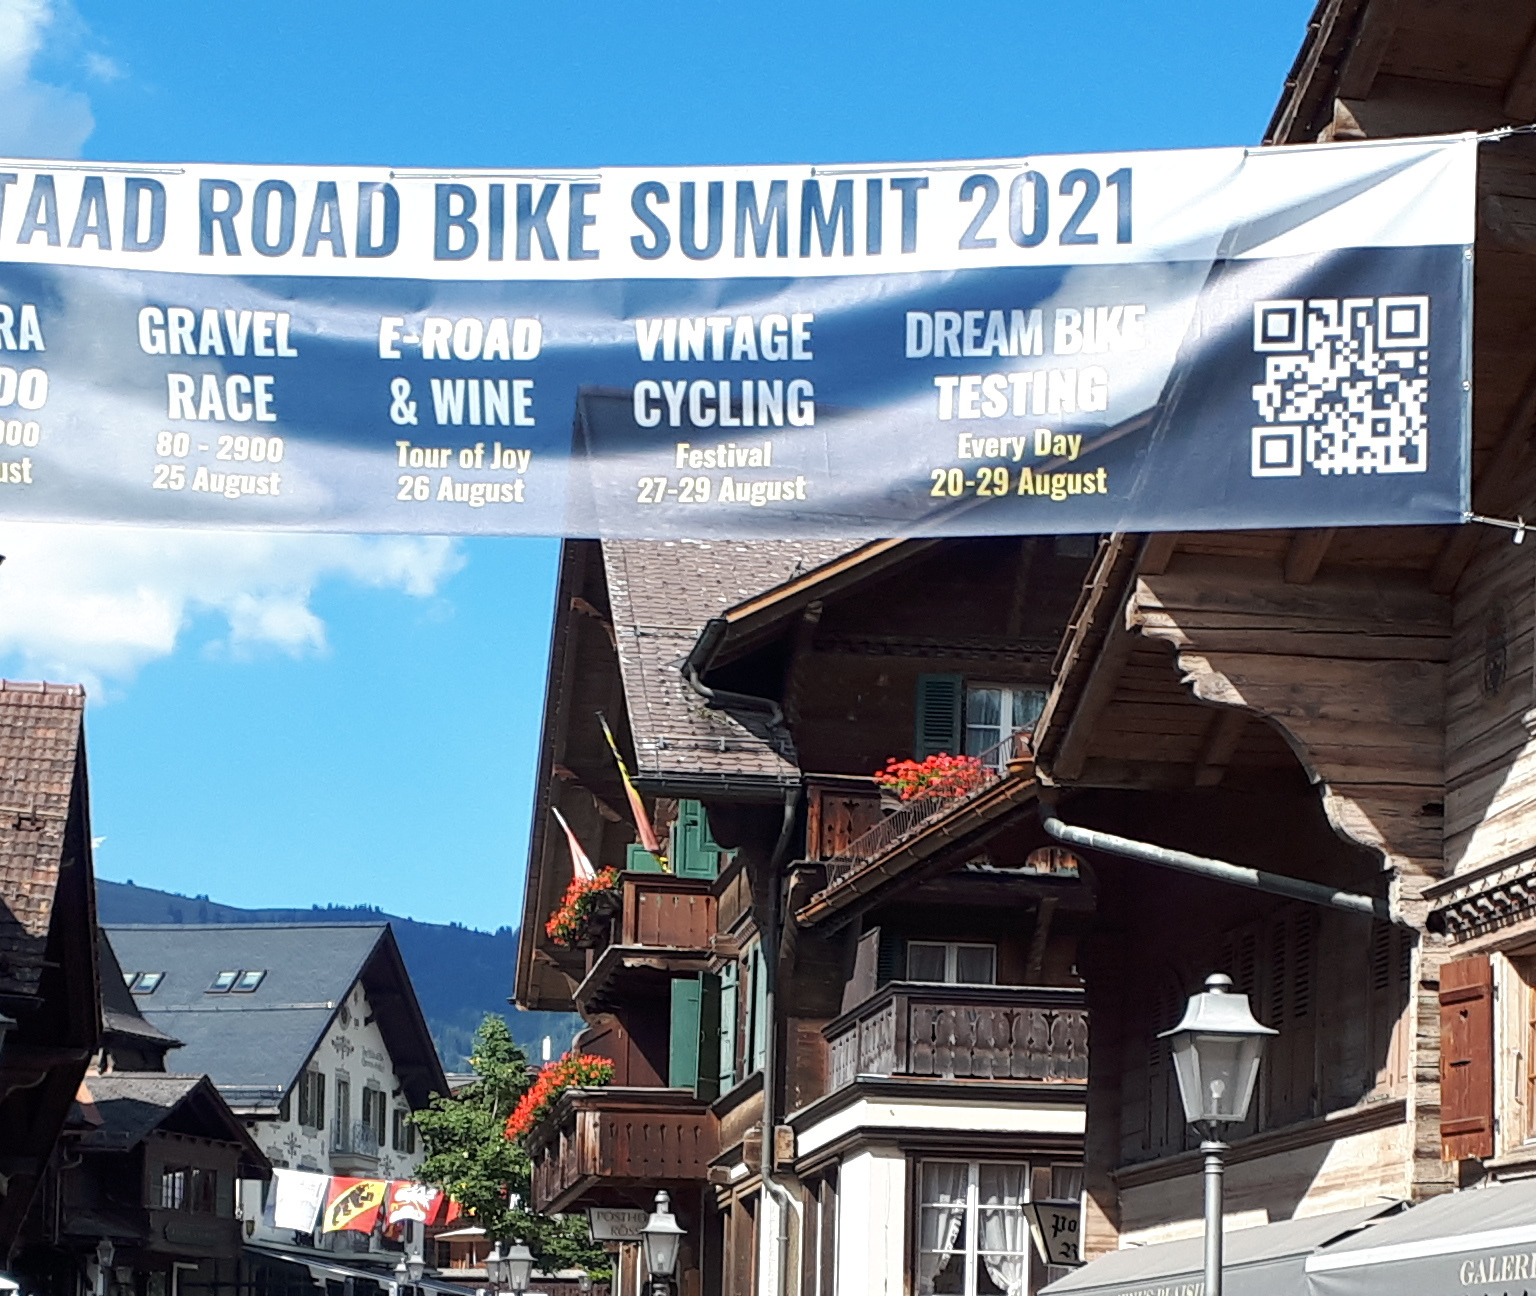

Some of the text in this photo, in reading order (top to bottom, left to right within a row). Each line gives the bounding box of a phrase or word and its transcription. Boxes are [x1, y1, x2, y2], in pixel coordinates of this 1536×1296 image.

[197, 177, 400, 260] ROAD
[433, 181, 601, 262] BIKE
[630, 176, 930, 262] SUMMIT
[957, 167, 1134, 250] 2021
[137, 306, 299, 357] GRAVEL
[378, 316, 543, 361] E-ROAD
[634, 313, 814, 361] VINTAGE
[905, 304, 1149, 359] DREAM BIKE
[167, 373, 277, 422] RACE
[390, 377, 536, 427] & WINE
[633, 379, 815, 428] CYCLING
[933, 365, 1109, 421] TESTING
[155, 431, 189, 457] 80
[216, 435, 284, 463] 2900
[395, 441, 531, 475] Tour of Joy
[675, 441, 772, 469] Festival
[957, 428, 1082, 463] Every Day
[152, 464, 281, 498] 25 August
[396, 475, 525, 507] 26 August
[636, 476, 807, 506] 27-29 August
[930, 466, 1108, 501] 20-29 August
[597, 1210, 649, 1223] POSTHO
[611, 1223, 641, 1237] RÖSS
